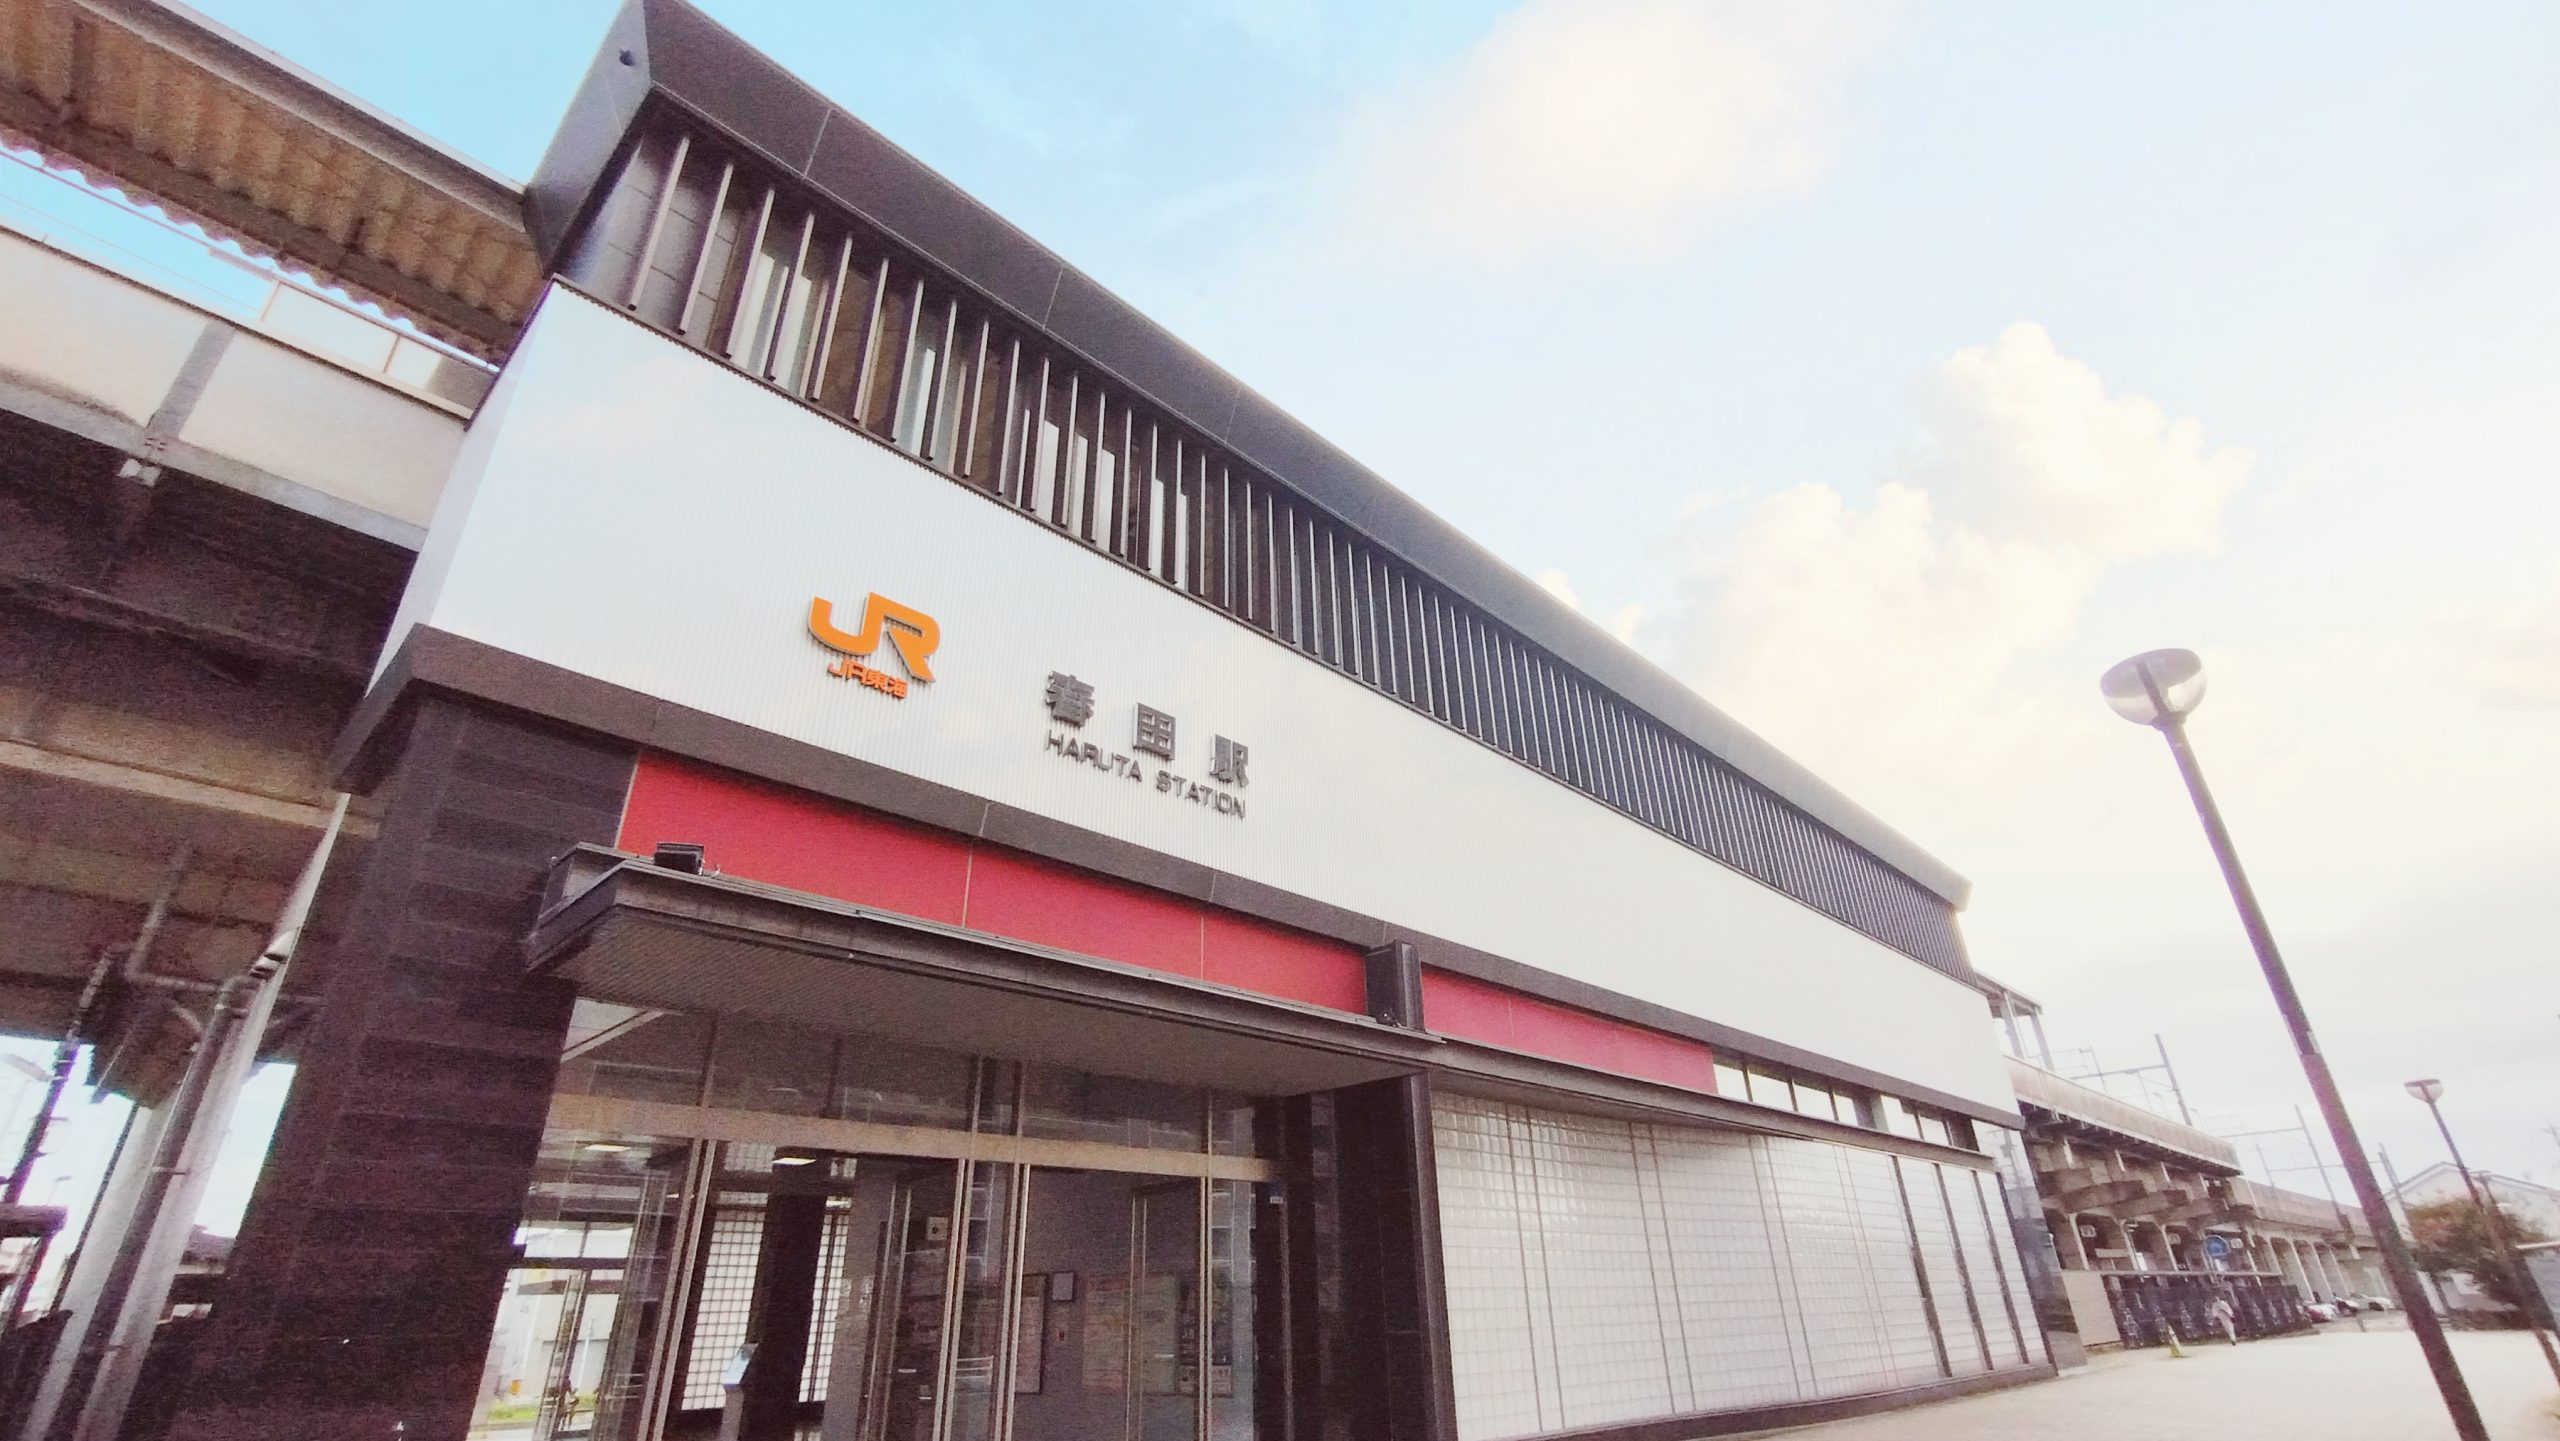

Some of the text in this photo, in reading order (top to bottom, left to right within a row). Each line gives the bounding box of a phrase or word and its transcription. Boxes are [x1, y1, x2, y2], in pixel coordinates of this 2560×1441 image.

[808, 591, 940, 682] JR
[826, 657, 909, 699] JR東海
[1045, 729, 1247, 819] HARUTA STATION
